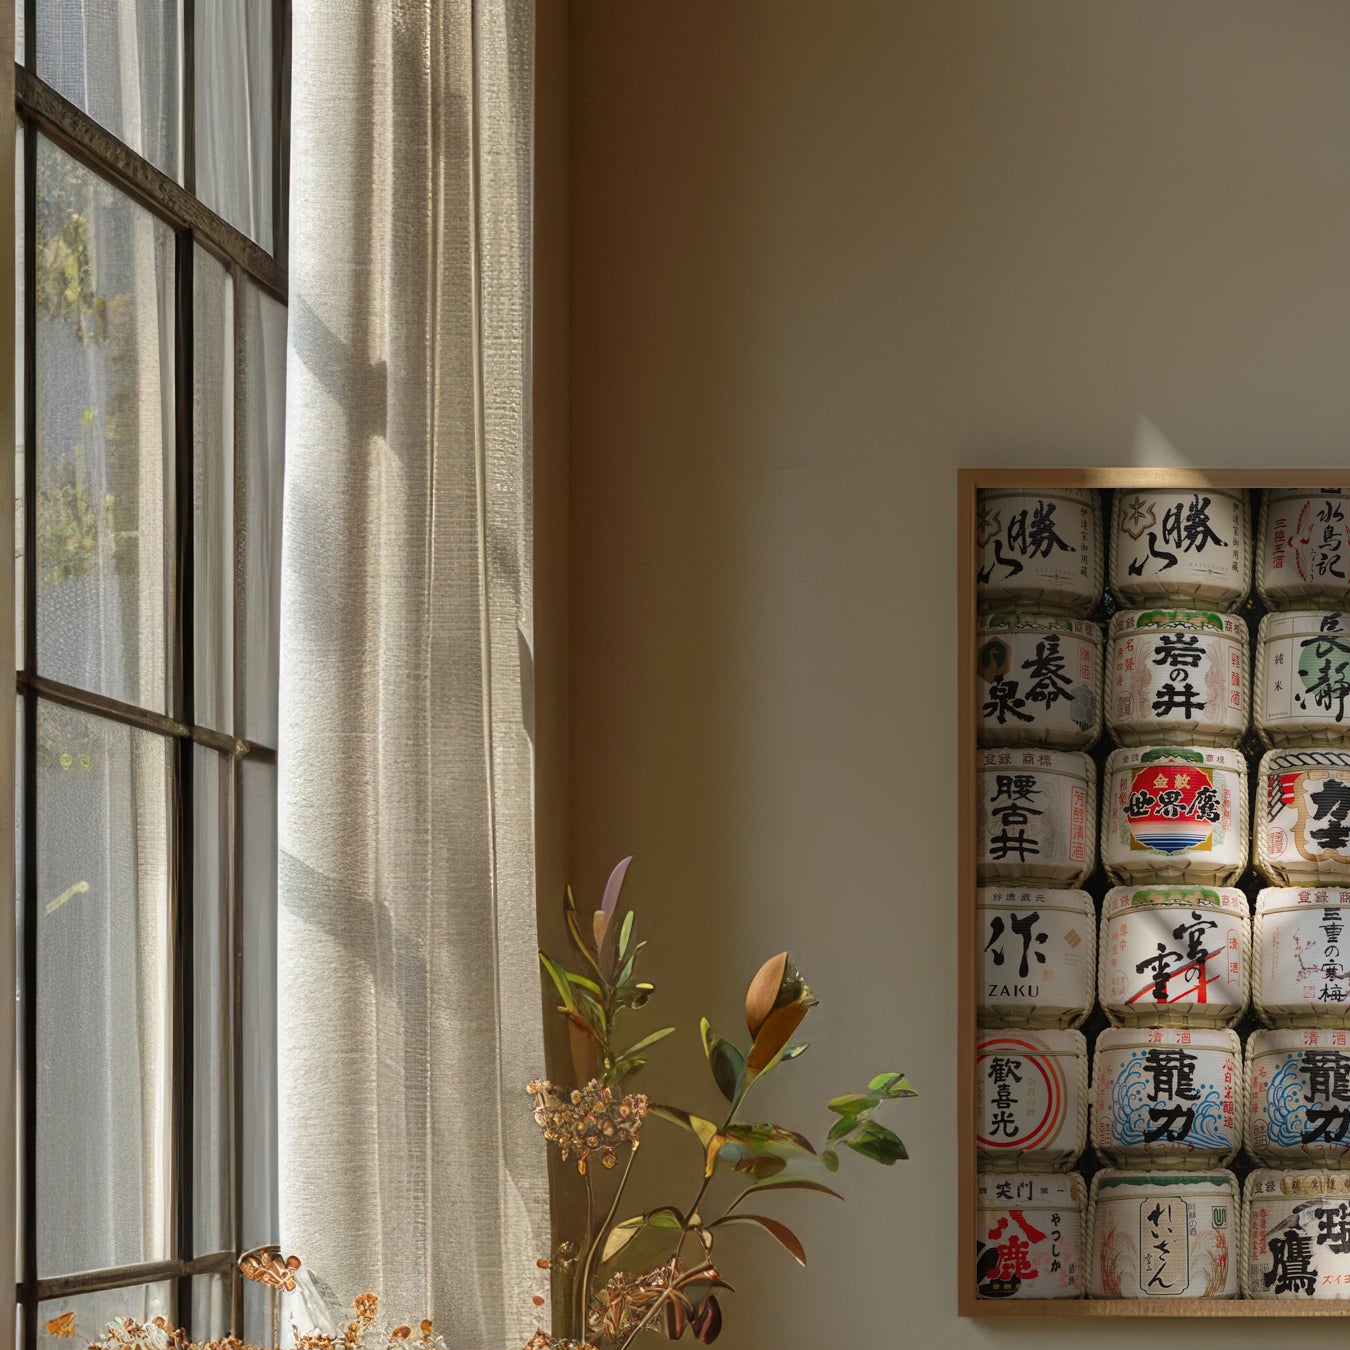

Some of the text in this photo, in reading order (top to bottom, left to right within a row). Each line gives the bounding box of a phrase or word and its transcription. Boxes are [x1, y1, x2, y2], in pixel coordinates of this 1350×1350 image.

[1316, 501, 1345, 578] 水鳥記
[1152, 632, 1208, 719] 岩の井
[1274, 653, 1286, 691] 純米
[989, 774, 1043, 863] 腰古井
[985, 911, 1049, 978] 作
[1228, 937, 1238, 973] 清酒
[1318, 908, 1347, 1002] 三重の寒梅
[988, 984, 1039, 998] ZAKU
[1148, 1031, 1191, 1044] 清酒
[1304, 1031, 1347, 1045] 清酒
[1143, 1049, 1201, 1143] 龍力
[996, 1180, 1033, 1201] 笑門
[987, 1205, 1048, 1280] 八鹿
[1051, 1213, 1061, 1272] やつしか
[1147, 1202, 1178, 1289] れいざん
